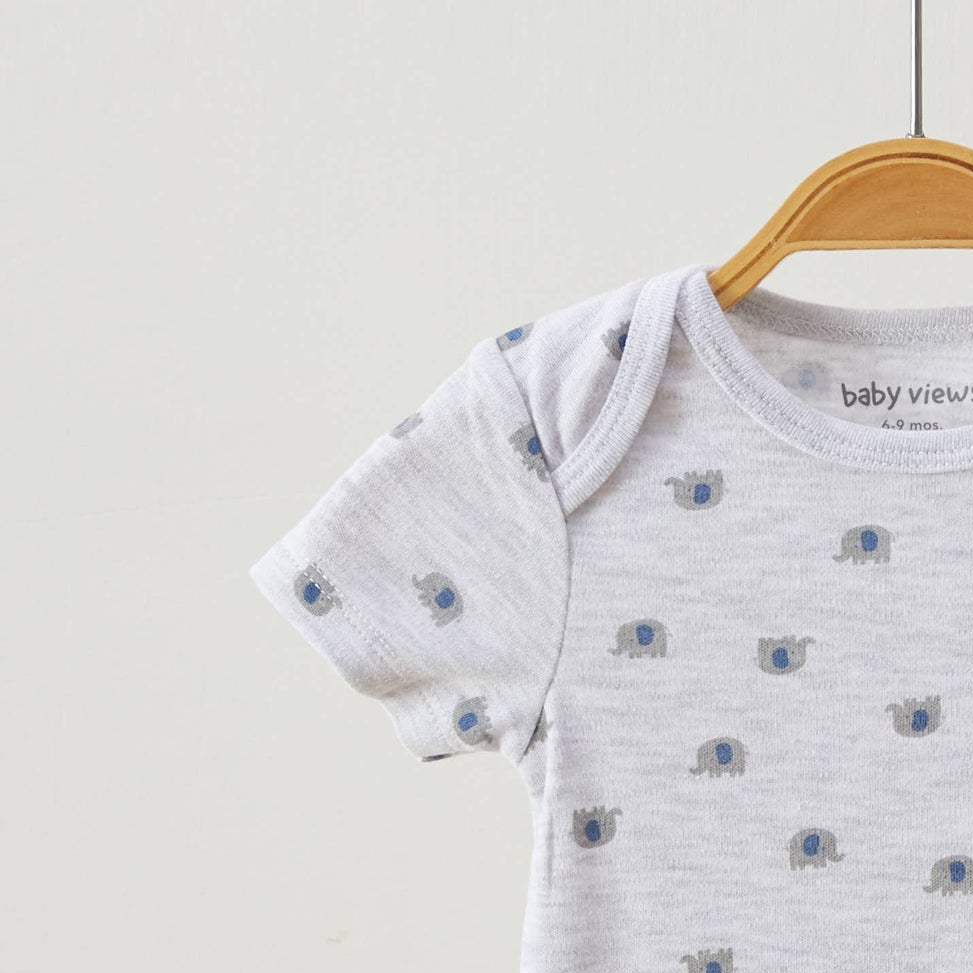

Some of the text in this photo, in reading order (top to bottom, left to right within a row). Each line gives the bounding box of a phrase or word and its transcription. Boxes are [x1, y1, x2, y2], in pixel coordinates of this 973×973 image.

[841, 380, 902, 411] baby
[881, 418, 943, 431] 6-9 mos.
